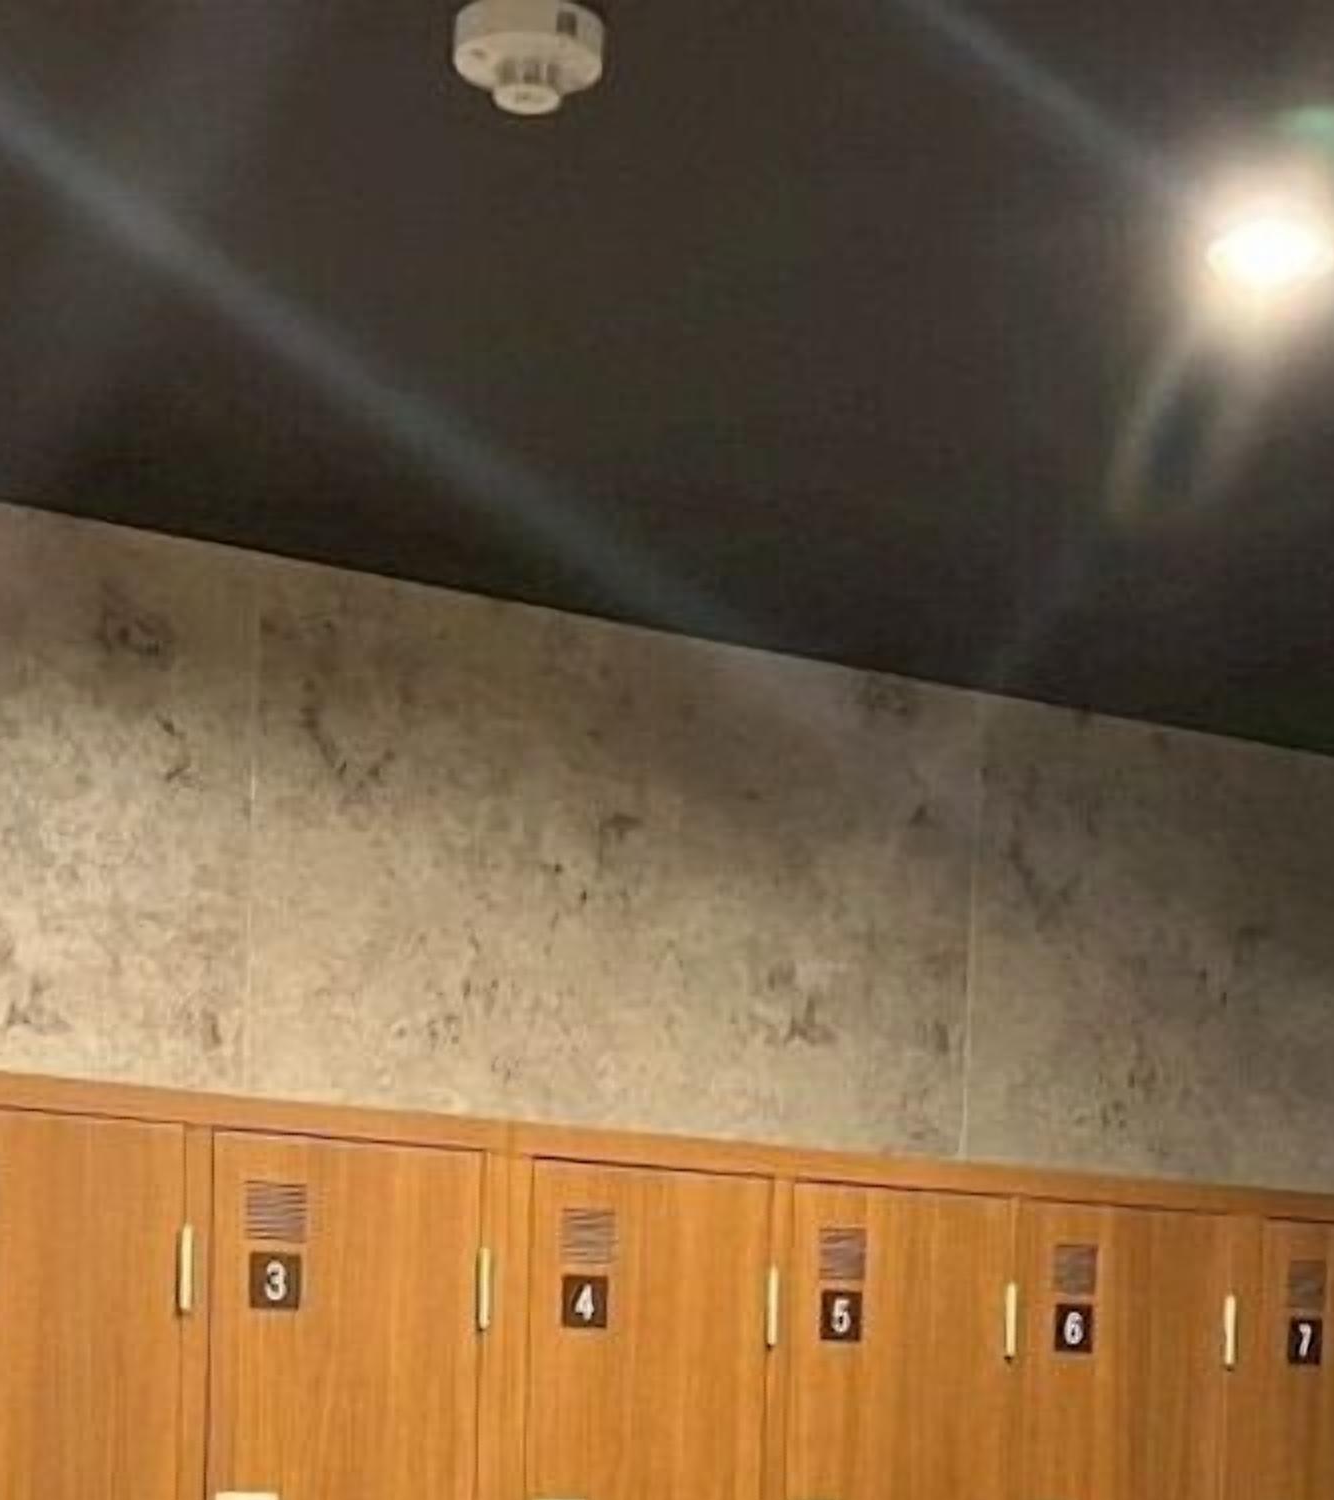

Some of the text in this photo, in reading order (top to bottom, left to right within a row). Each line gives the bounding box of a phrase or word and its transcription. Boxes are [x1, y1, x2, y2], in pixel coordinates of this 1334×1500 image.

[265, 1260, 286, 1301] 3
[575, 1284, 594, 1321] 4
[831, 1299, 851, 1334] 5
[1064, 1311, 1082, 1345] 6
[1298, 1324, 1312, 1357] 7
